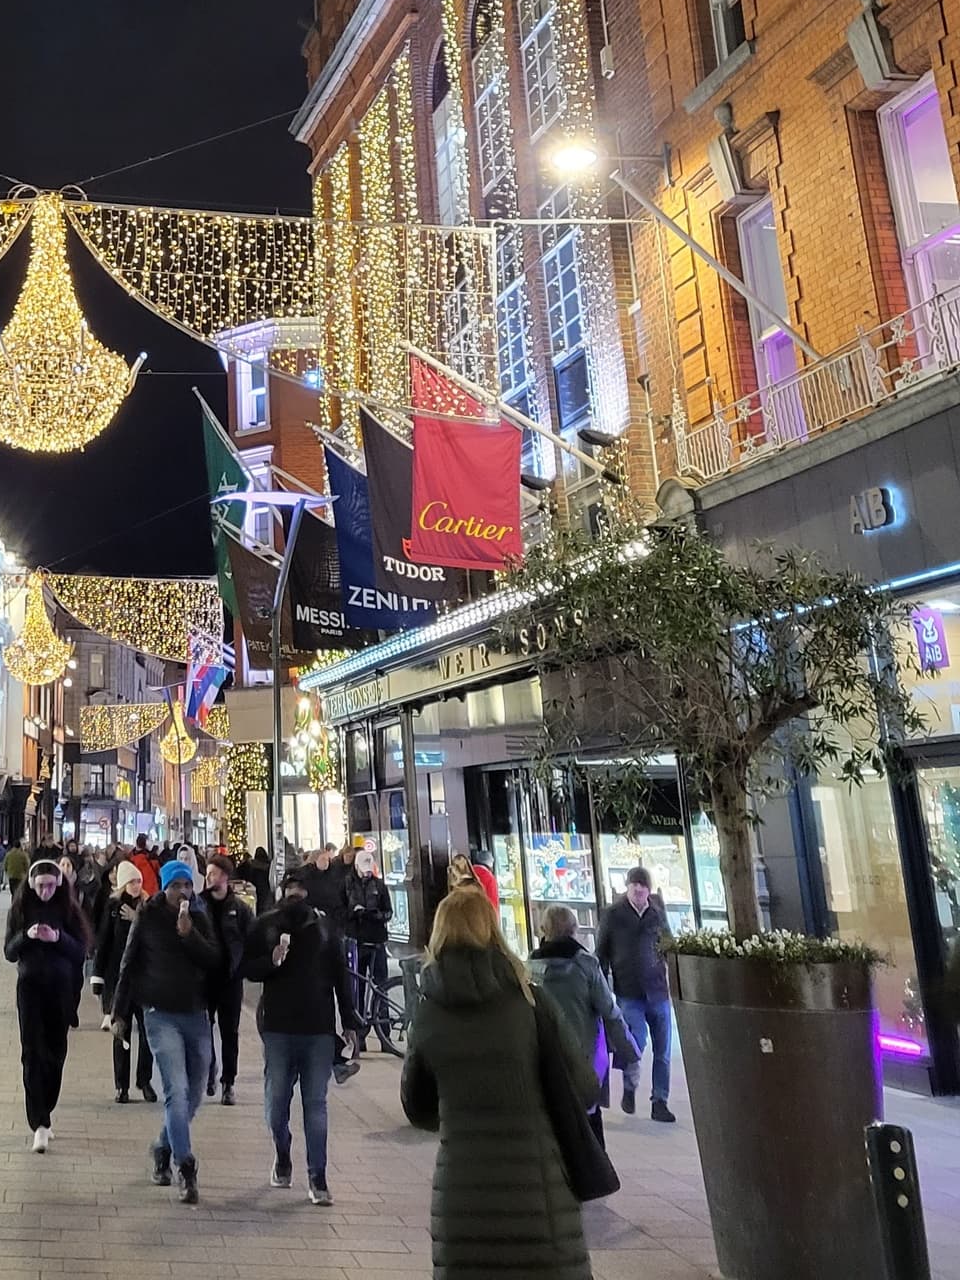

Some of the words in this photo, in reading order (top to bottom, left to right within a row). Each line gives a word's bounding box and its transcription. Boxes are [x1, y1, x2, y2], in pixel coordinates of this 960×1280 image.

[418, 500, 514, 542] Cartier
[849, 486, 893, 535] AIB
[382, 555, 447, 582] TUDOR
[295, 603, 361, 630] MESSI
[320, 627, 344, 637] PARIS
[439, 643, 491, 681] WEIR
[924, 644, 943, 664] AIB
